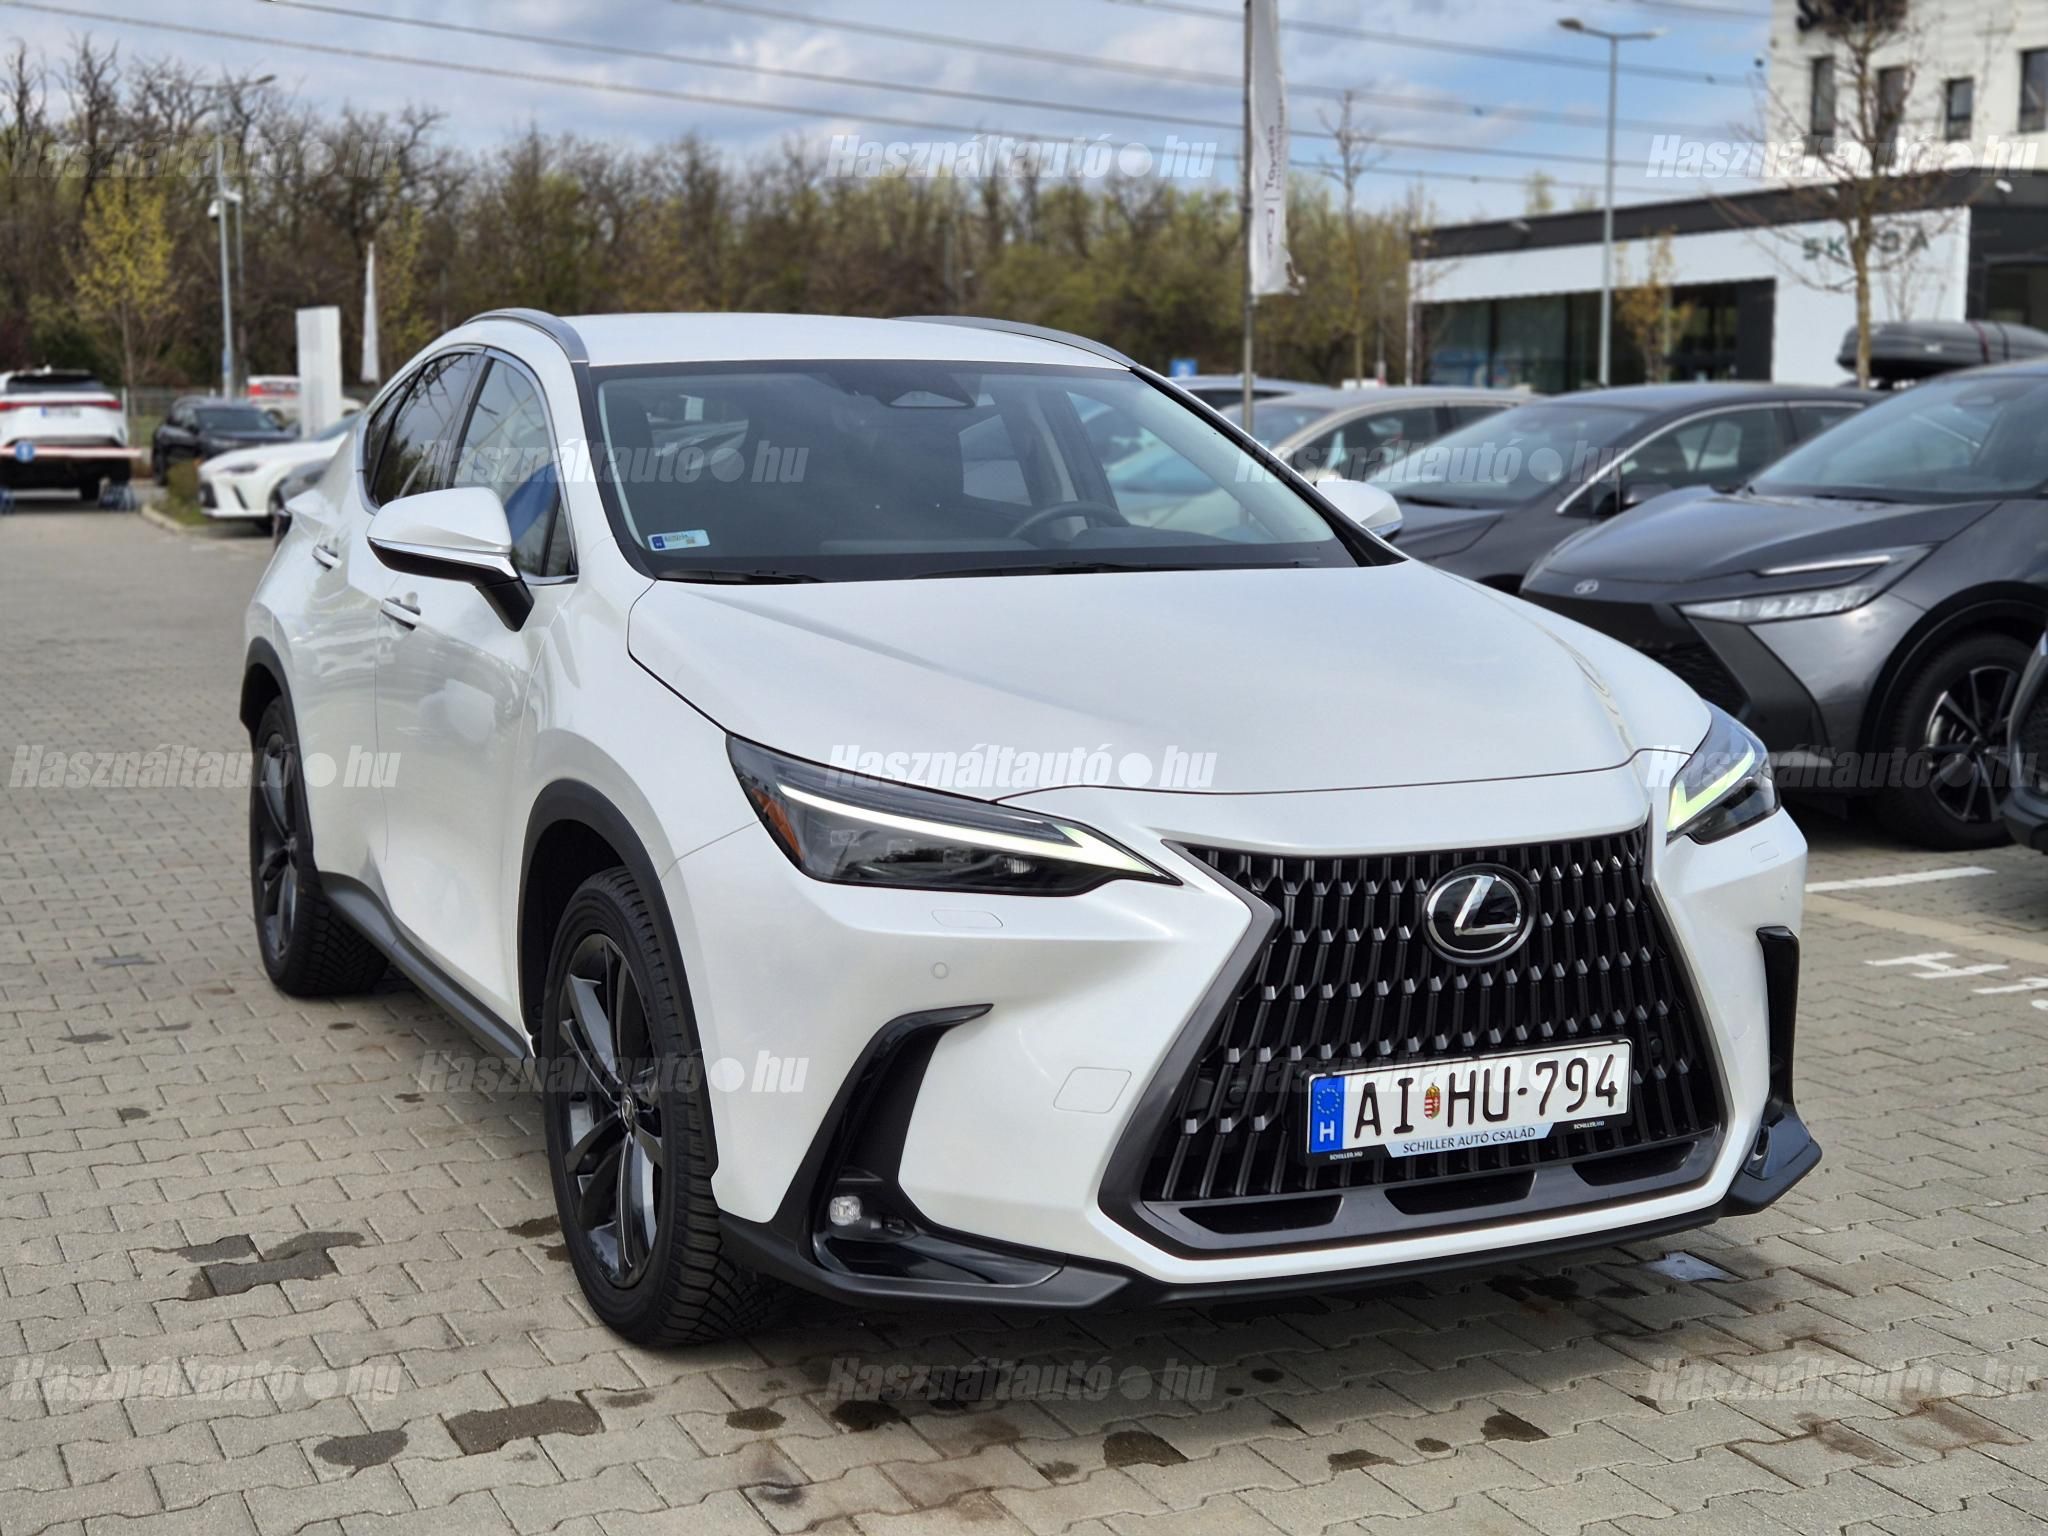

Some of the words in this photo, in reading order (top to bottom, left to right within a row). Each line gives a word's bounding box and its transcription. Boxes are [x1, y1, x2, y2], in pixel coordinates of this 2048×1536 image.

[1354, 1077, 1415, 1140] AI
[1447, 1053, 1618, 1129] HU-794
[1318, 1121, 1336, 1143] H
[1402, 1137, 1456, 1154] SCHILLER
[1457, 1130, 1490, 1147] AUTÓ
[1492, 1125, 1536, 1143] CSALÁD
